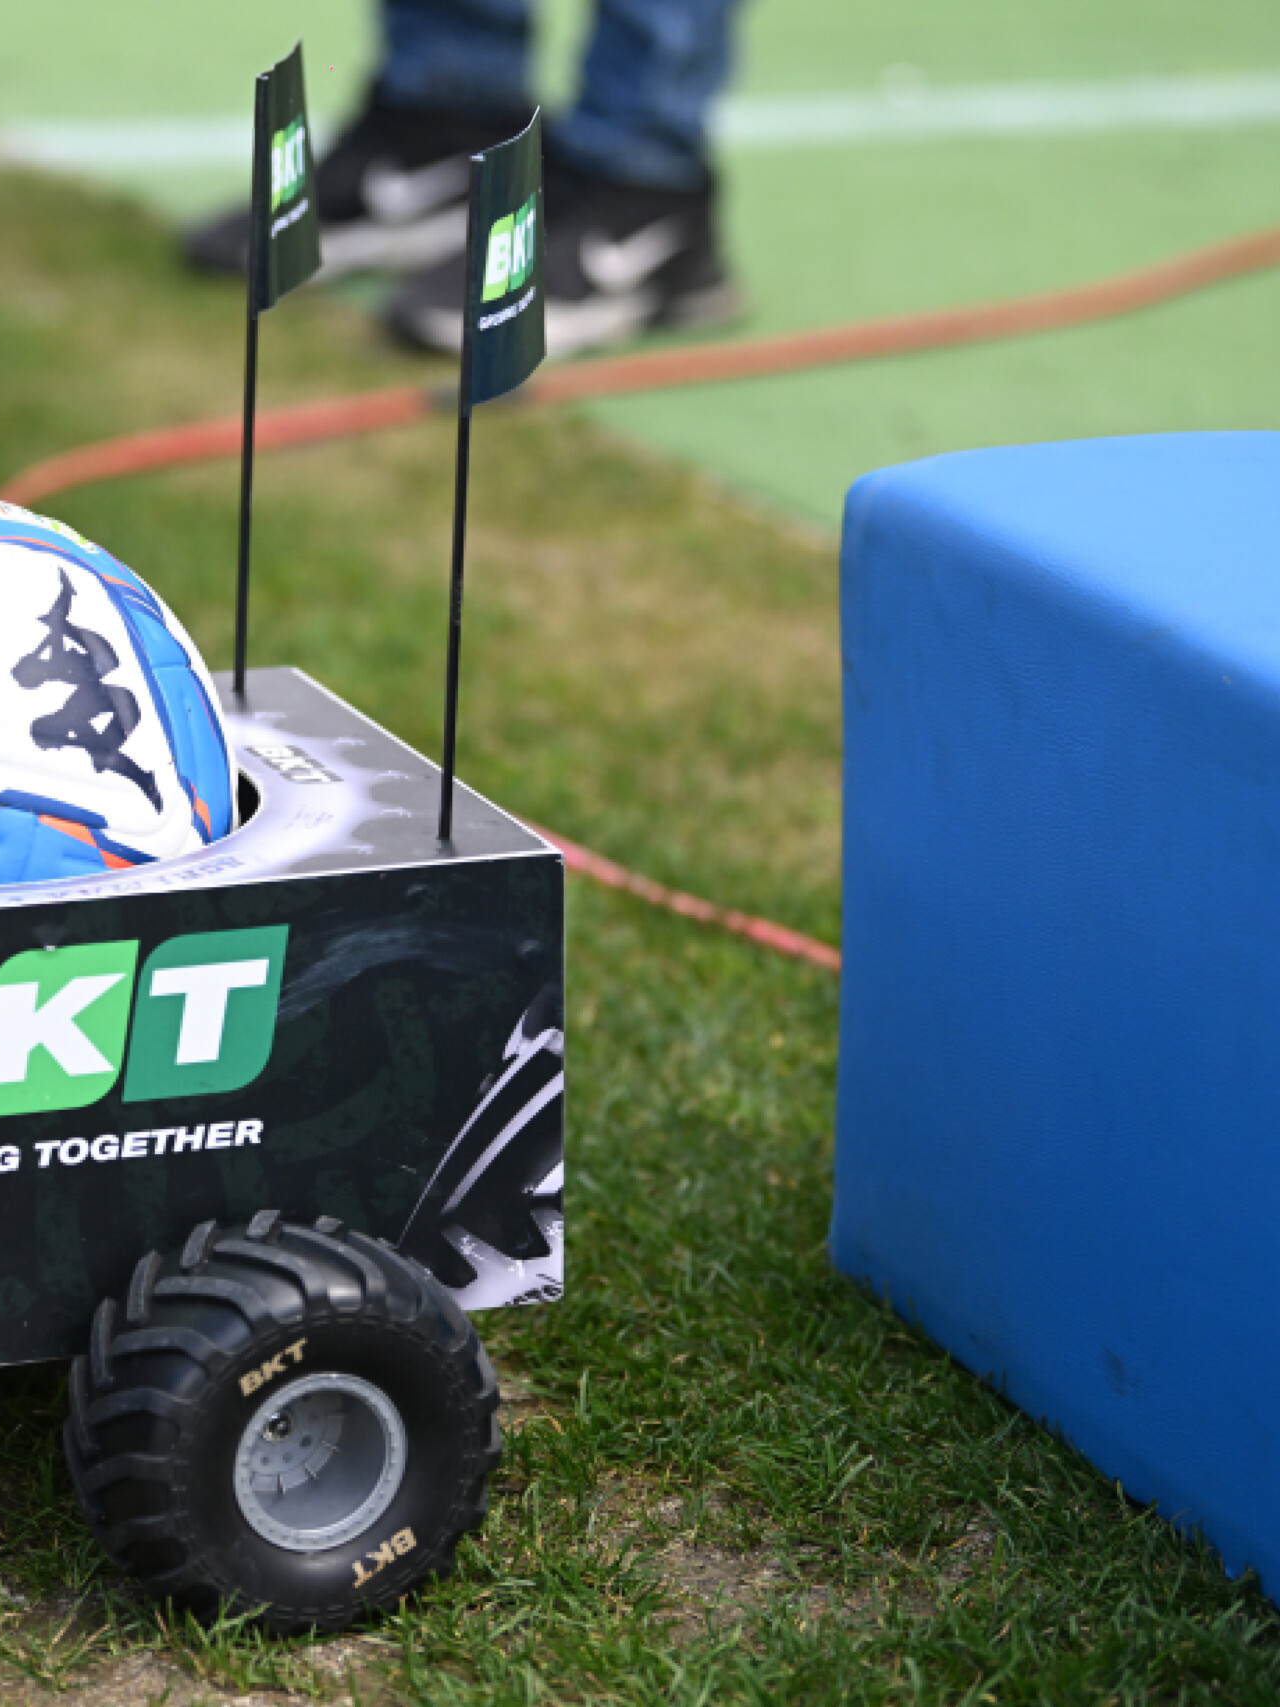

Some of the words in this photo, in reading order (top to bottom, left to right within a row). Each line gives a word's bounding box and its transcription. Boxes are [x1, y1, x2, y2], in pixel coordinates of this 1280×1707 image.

[485, 208, 536, 285] BKT
[33, 1118, 265, 1169] TOGETHER
[238, 1337, 309, 1397] BKT
[352, 1527, 418, 1588] BKT
